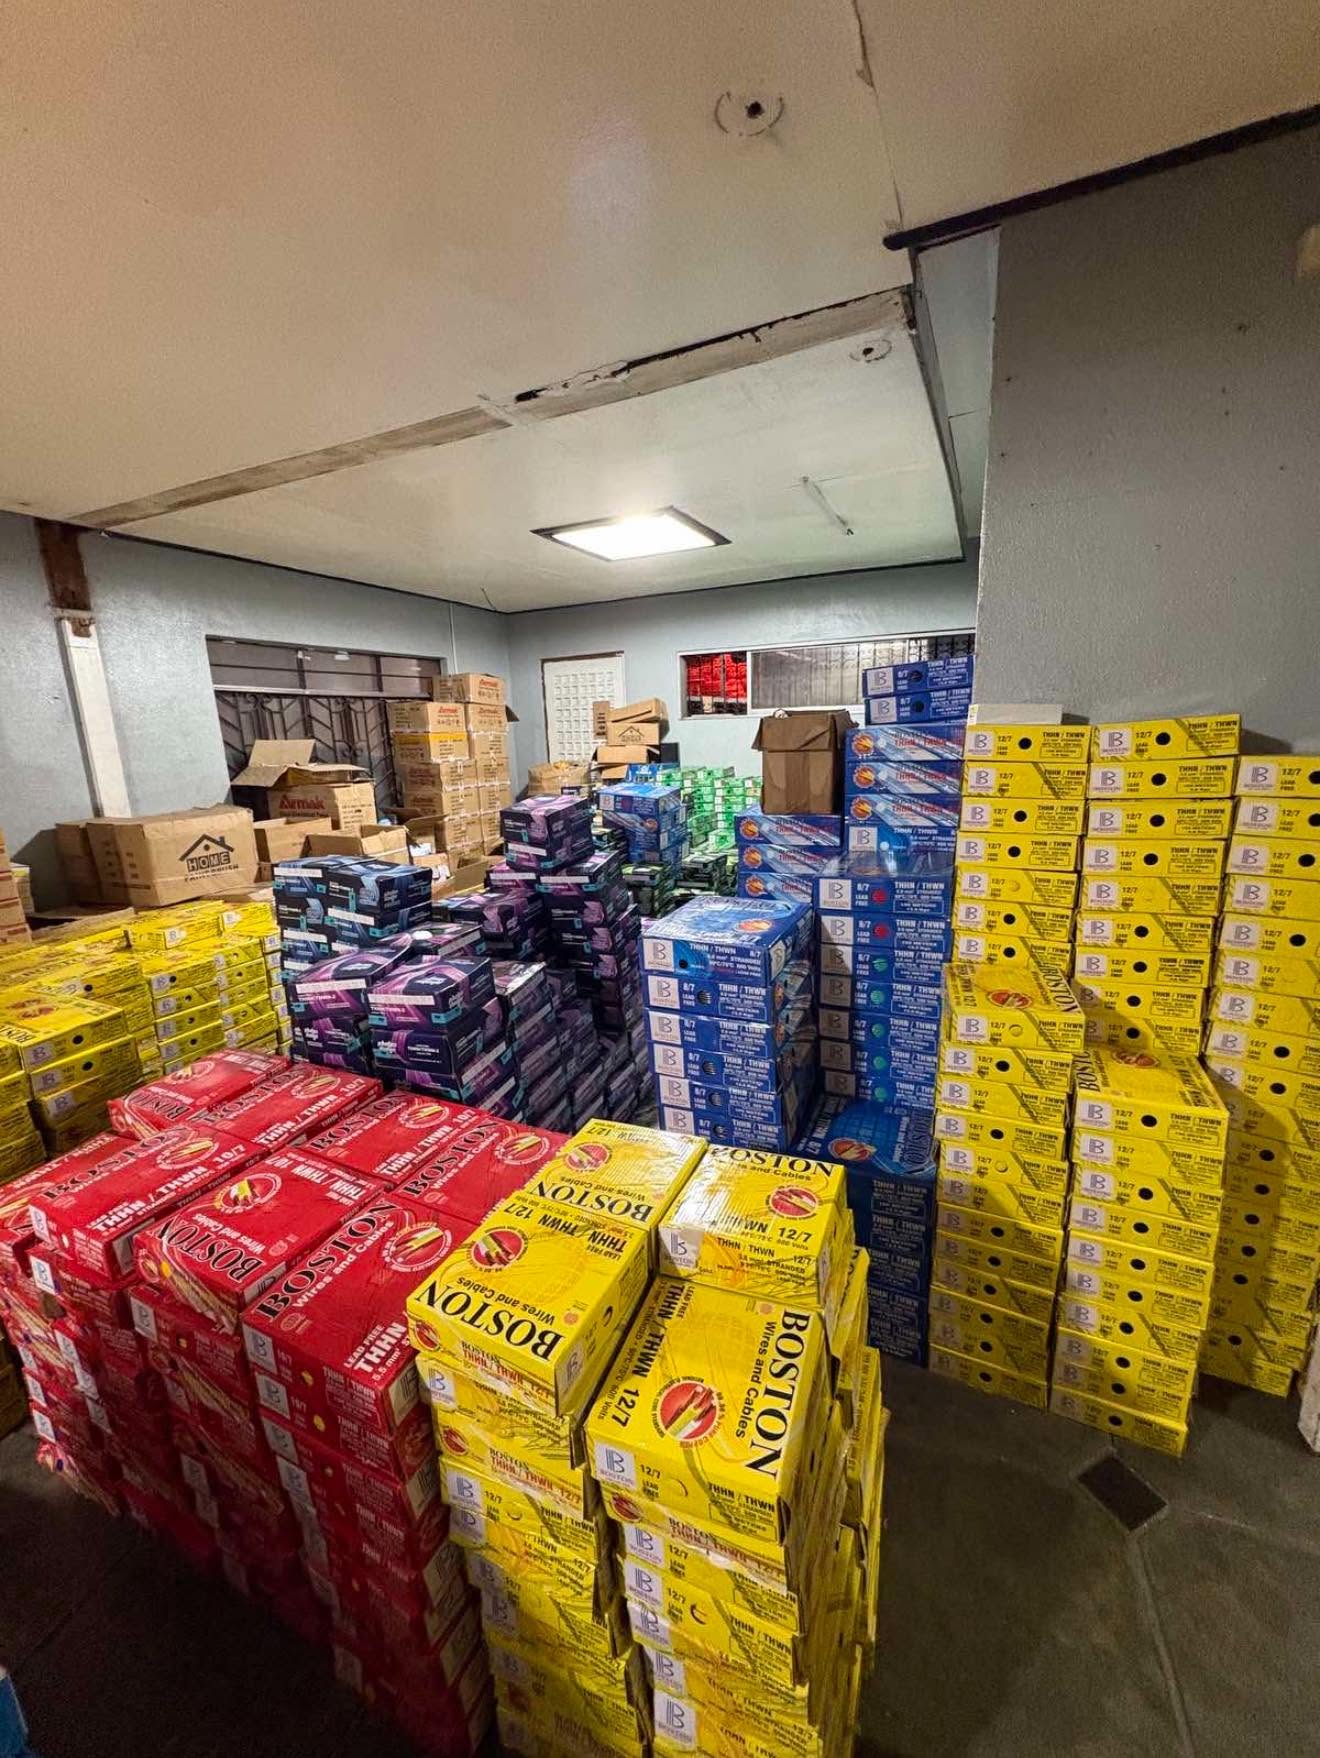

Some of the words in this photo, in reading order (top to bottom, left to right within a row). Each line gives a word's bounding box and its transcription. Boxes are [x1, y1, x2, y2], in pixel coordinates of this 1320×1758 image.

[1282, 768, 1303, 776] 12/7
[186, 850, 232, 873] HOME
[380, 1151, 416, 1176] THHN
[418, 1125, 453, 1148] THWN
[452, 1109, 476, 1125] 10/7
[585, 1126, 613, 1138] 12/7
[156, 1165, 210, 1195] THWN
[213, 1145, 247, 1164] 10/7
[264, 1155, 295, 1169] 10/7
[292, 1163, 326, 1184] THWN
[773, 1168, 813, 1182] Cables
[327, 1179, 367, 1201] THHN
[530, 1179, 654, 1225] BOSTON
[503, 1202, 535, 1220] 12/7
[537, 1212, 581, 1237] THWN
[587, 1230, 628, 1253] THHN
[778, 1226, 814, 1244] 12/7
[156, 1215, 265, 1284] BOSTON
[252, 1199, 401, 1322] BOSTON
[717, 1237, 742, 1251] THHN
[749, 1244, 776, 1259] THWN
[792, 1254, 813, 1267] 12/7
[292, 1276, 334, 1309] Wires
[332, 1253, 359, 1276] and
[354, 1220, 396, 1254] Cables
[456, 1275, 496, 1301] Cables
[495, 1292, 519, 1308] and
[657, 1283, 686, 1320] THHN
[414, 1279, 567, 1363] BOSTON
[521, 1304, 556, 1326] Wires
[343, 1343, 370, 1369] LEAD
[363, 1324, 387, 1346] FREE
[353, 1321, 408, 1374] THHN
[757, 1320, 778, 1357] Wires
[632, 1329, 665, 1379] THWN
[750, 1358, 766, 1385] and
[611, 1387, 641, 1429] 12/7
[744, 1307, 814, 1481] BOSTON
[735, 1387, 760, 1440] Cables
[639, 1463, 661, 1480] 12/7
[485, 1490, 503, 1505] 12/7
[708, 1482, 736, 1499] THHN
[744, 1494, 776, 1513] THWN
[668, 1544, 689, 1560] 12/7
[667, 1586, 687, 1604] 12/7
[730, 1615, 756, 1636] THHN
[762, 1633, 792, 1656] THWN
